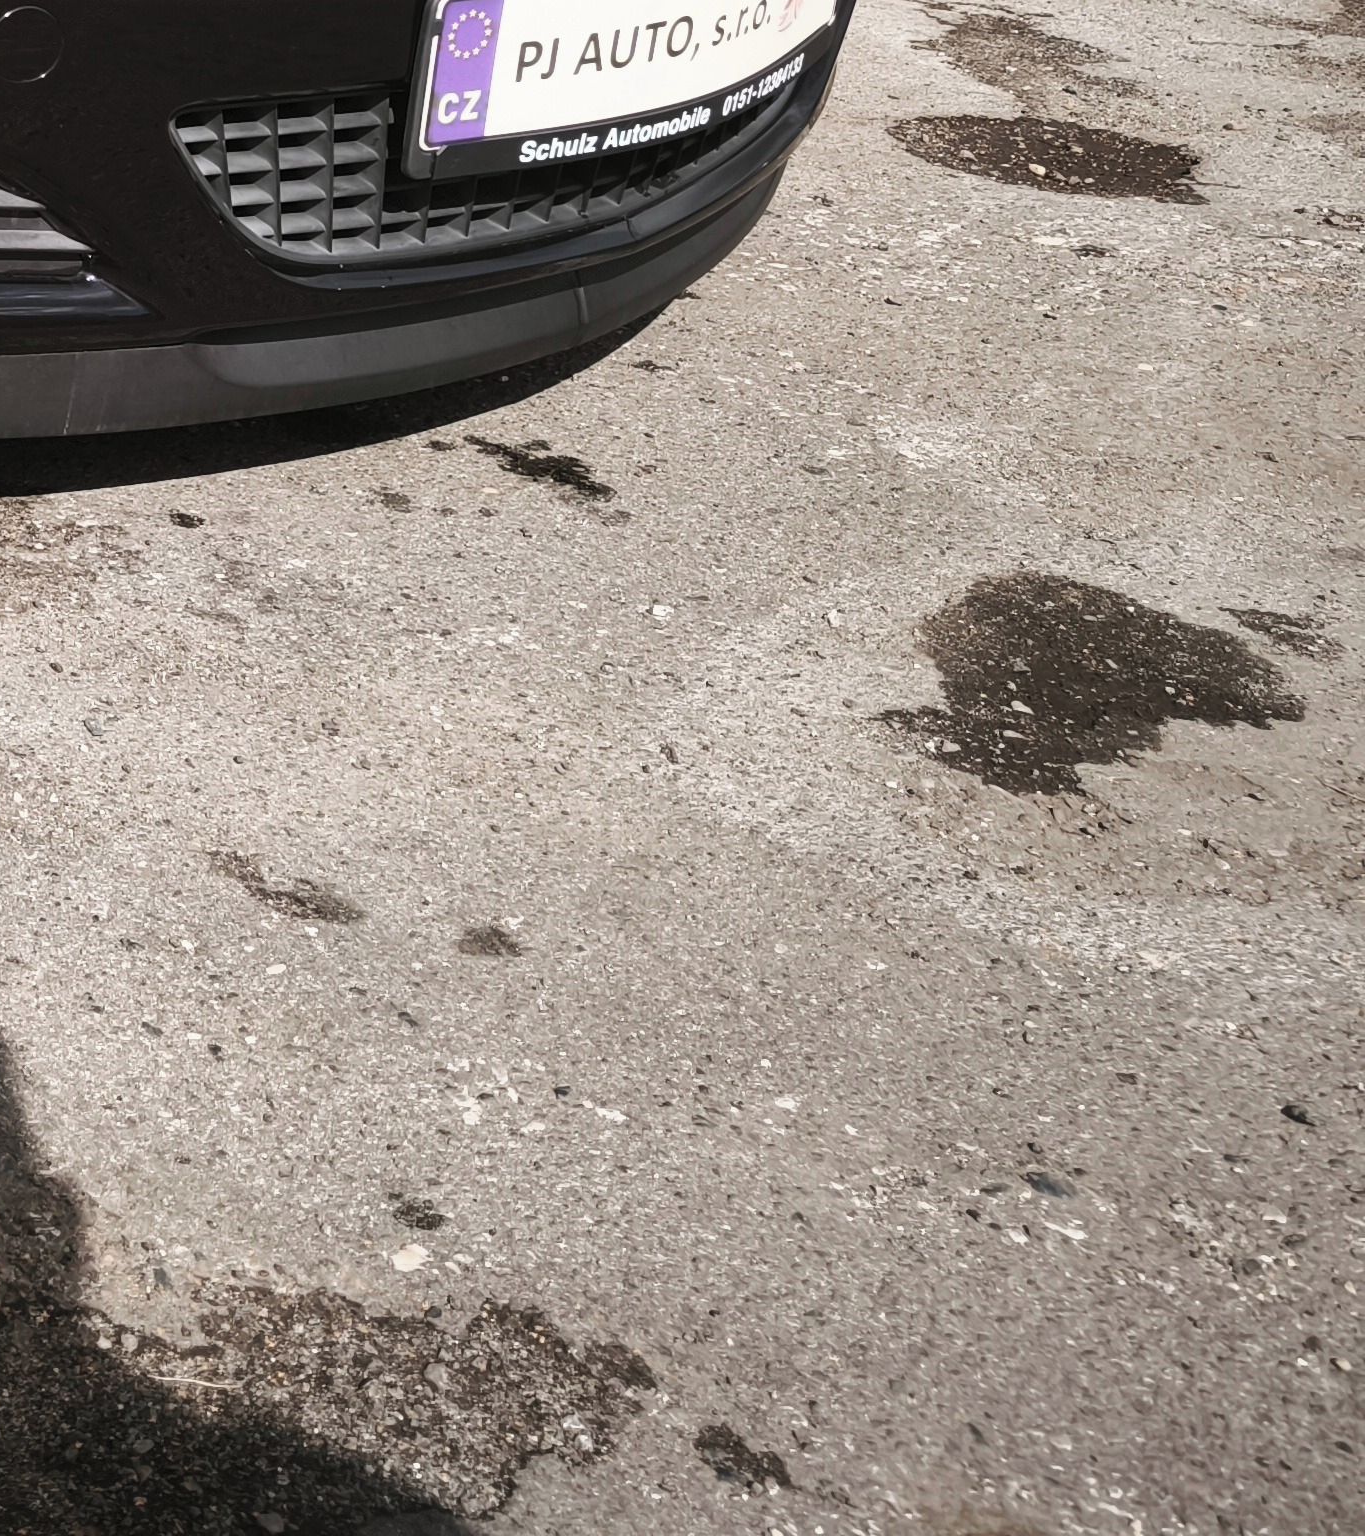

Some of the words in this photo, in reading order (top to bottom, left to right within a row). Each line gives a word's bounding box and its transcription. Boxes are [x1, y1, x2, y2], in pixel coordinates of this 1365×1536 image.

[515, 37, 560, 83] PJ
[572, 15, 700, 76] AUTO,
[711, 0, 771, 47] s.r.o.
[437, 89, 482, 125] CZ
[519, 133, 598, 163] Schulz
[602, 107, 711, 150] Automobile
